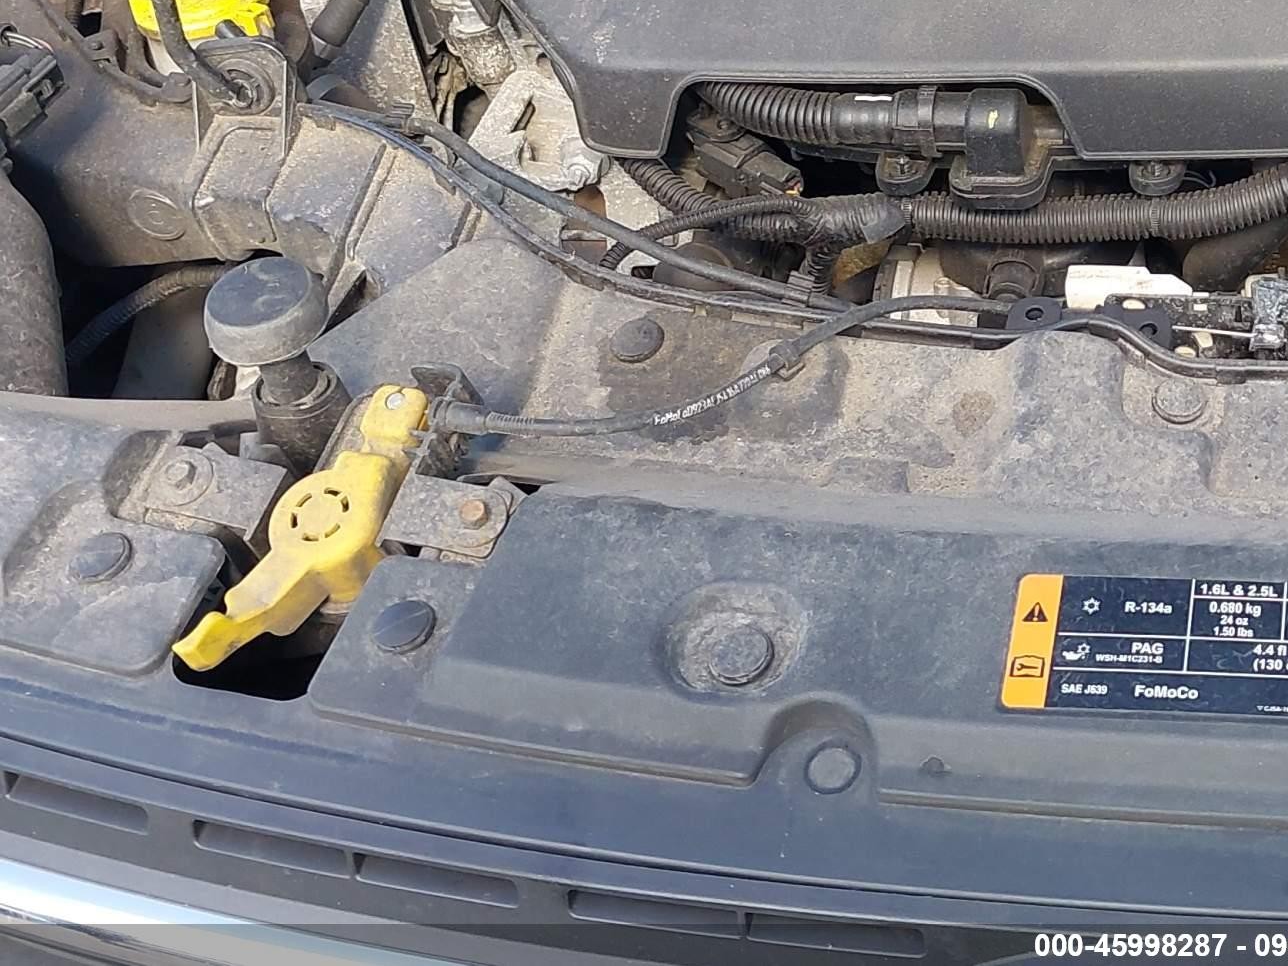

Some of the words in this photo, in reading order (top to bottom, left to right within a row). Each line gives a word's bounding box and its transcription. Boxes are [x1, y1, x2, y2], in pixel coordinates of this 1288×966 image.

[1199, 584, 1230, 597] 1.6L
[1232, 585, 1244, 597] &
[1247, 585, 1279, 599] 2.5L
[1125, 602, 1172, 613] R-134a
[1209, 602, 1243, 616] 0.680
[1245, 604, 1261, 618] kg
[1220, 615, 1232, 624] 24
[1214, 626, 1235, 636] 1.50
[1237, 627, 1253, 637] lbs
[1132, 642, 1163, 654] PAG
[1253, 644, 1274, 655] 4.4
[1278, 645, 1287, 656] fl
[1253, 658, 1280, 671] (130
[1061, 682, 1083, 693] SAE
[1135, 685, 1198, 699] FoMoCo
